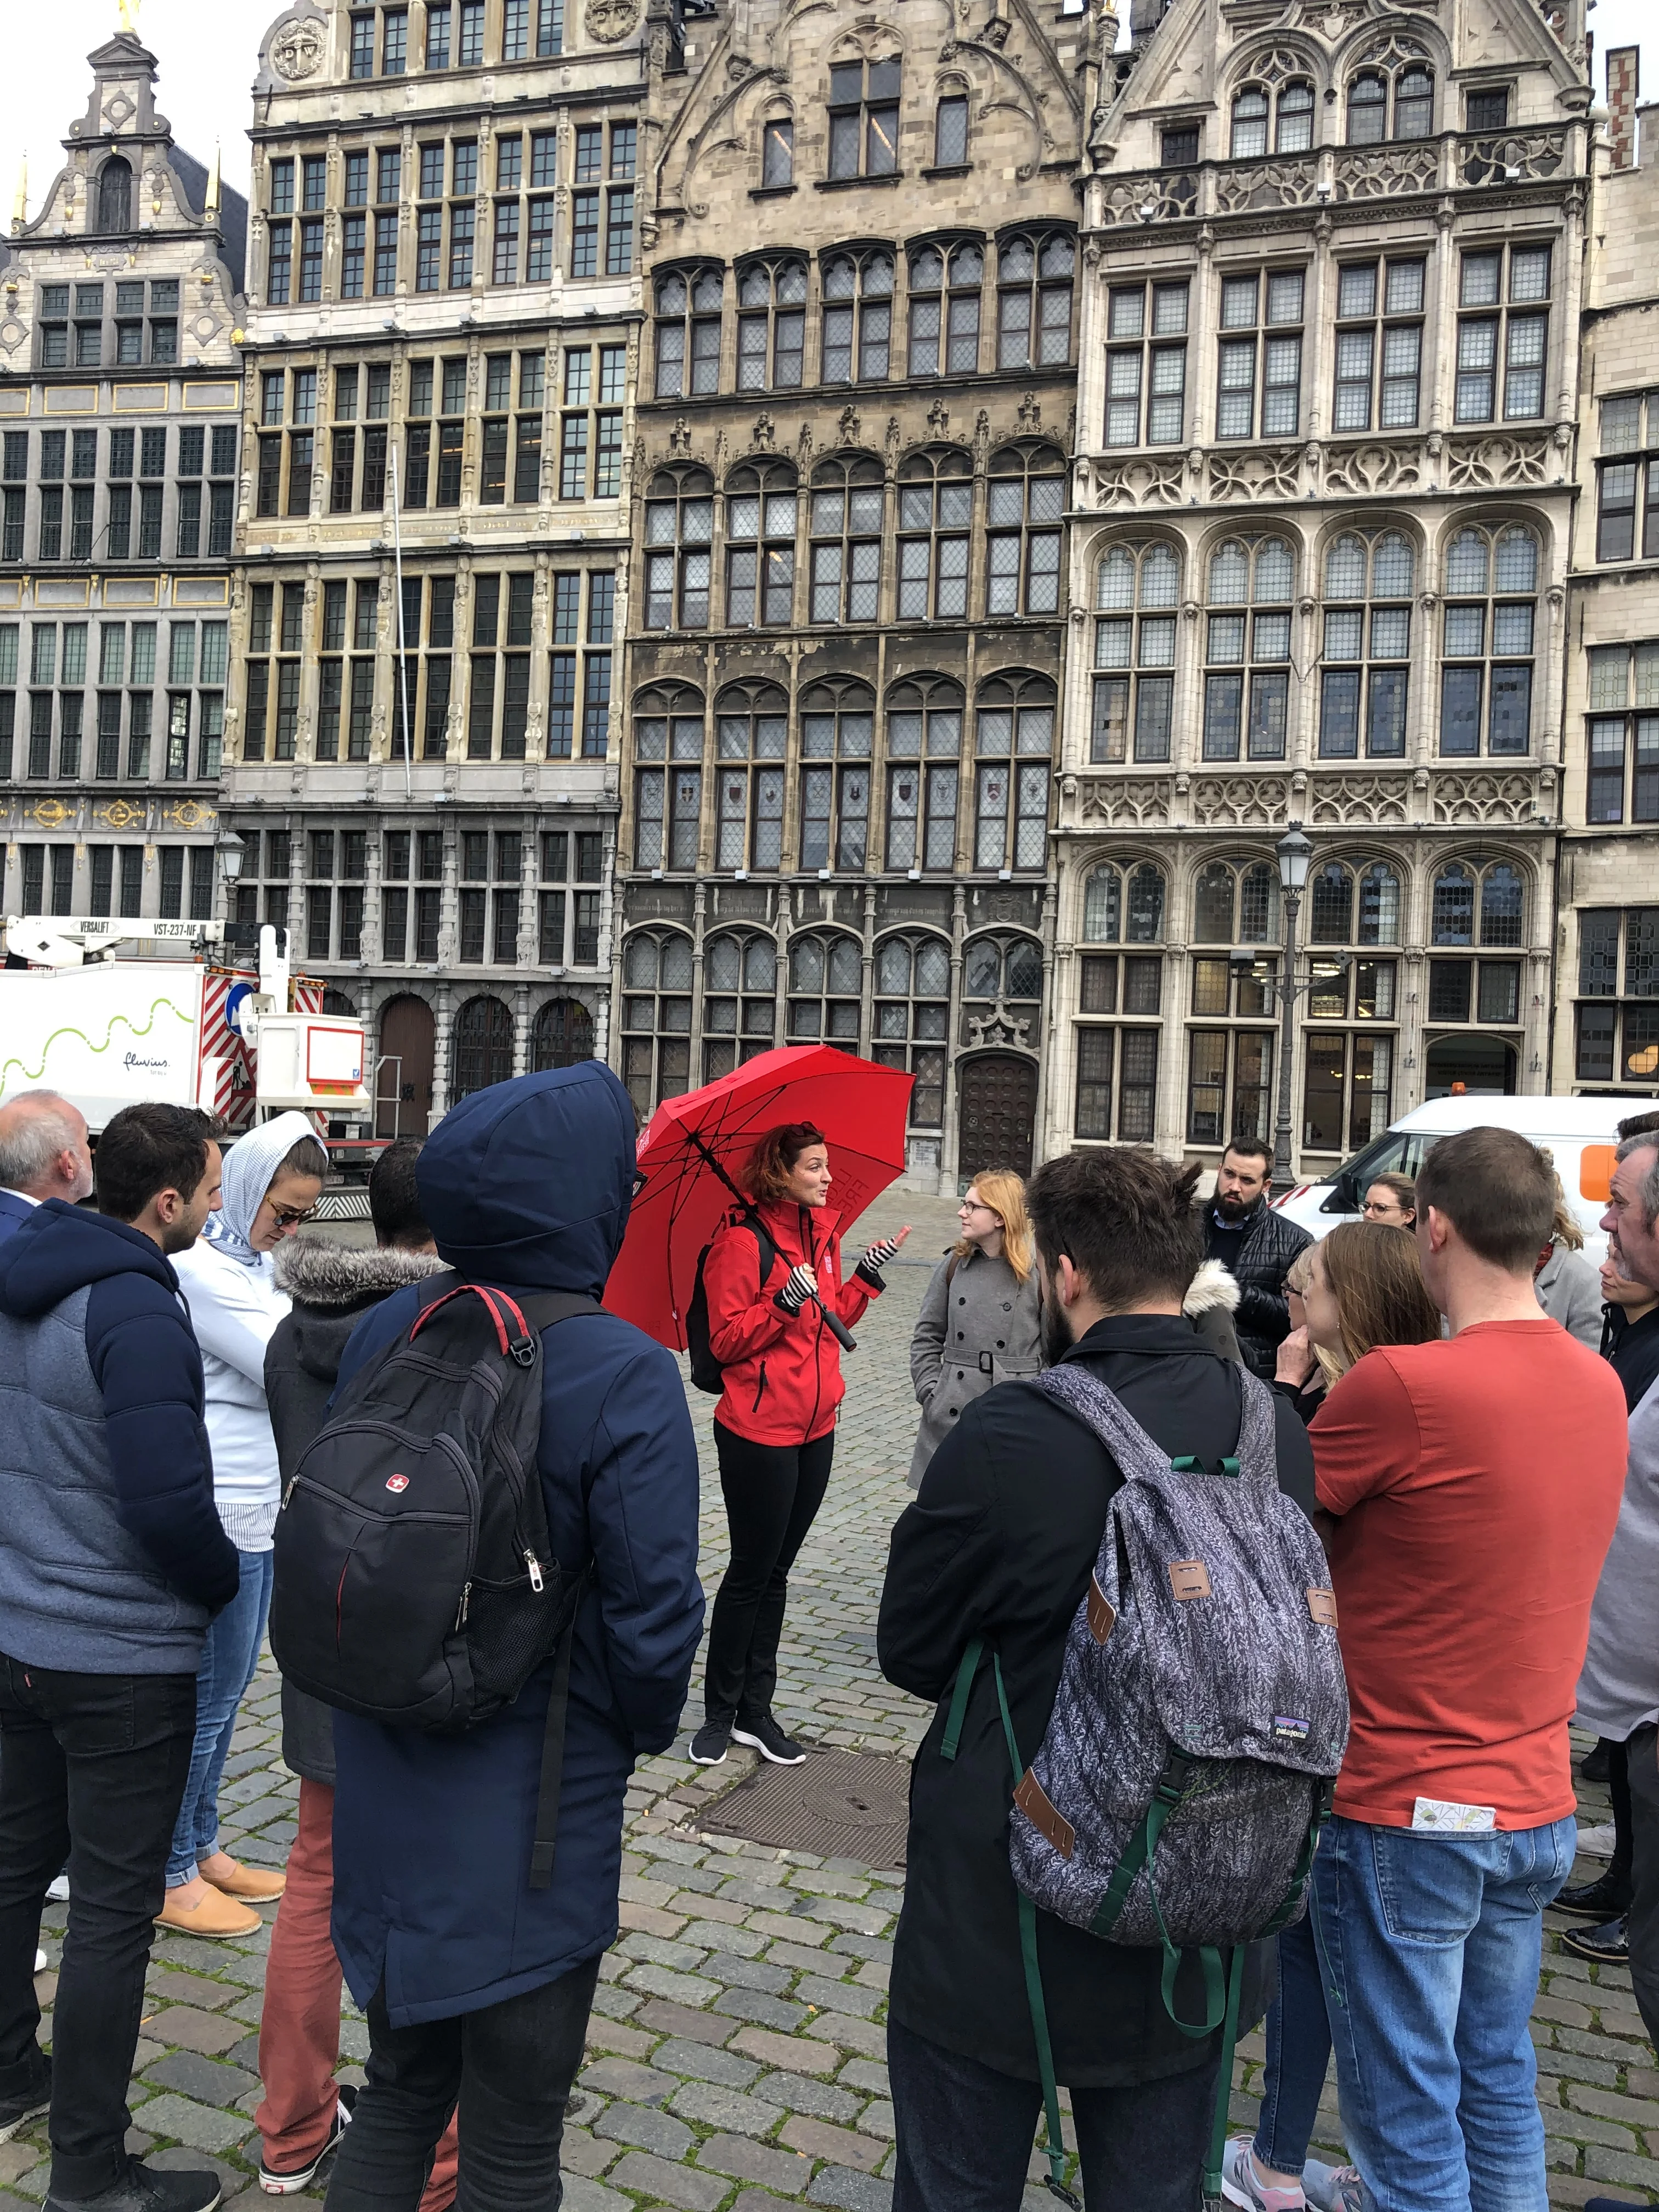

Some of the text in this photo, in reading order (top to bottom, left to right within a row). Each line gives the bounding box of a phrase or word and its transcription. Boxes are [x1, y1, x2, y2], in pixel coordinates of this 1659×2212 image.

[285, 46, 315, 58] D W
[80, 921, 109, 933] VERSALIFT
[154, 923, 197, 936] VST-237-NF
[1276, 1728, 1307, 1739] patagonia
